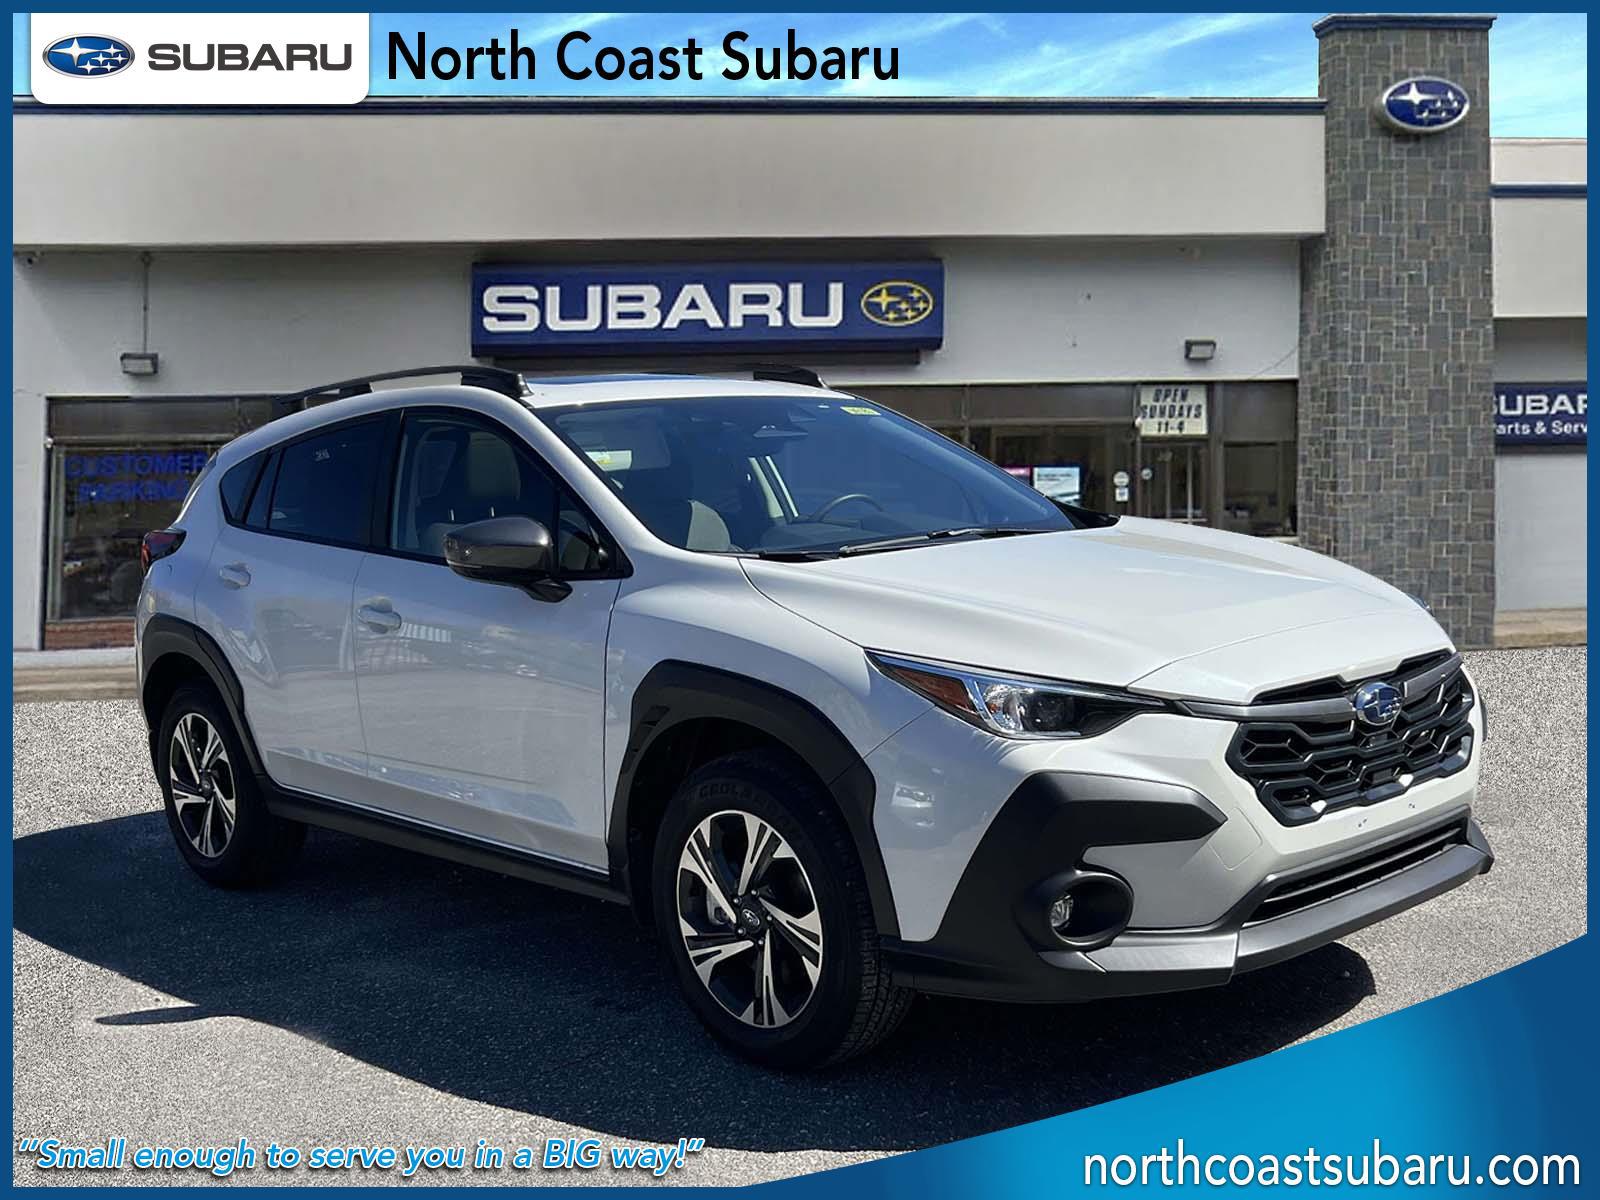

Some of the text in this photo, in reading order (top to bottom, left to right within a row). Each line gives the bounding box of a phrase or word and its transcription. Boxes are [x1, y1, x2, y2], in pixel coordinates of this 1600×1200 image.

[482, 282, 843, 332] SUBARU
[1153, 388, 1189, 403] OPEN
[1139, 404, 1203, 419] SUNDAYS
[1157, 420, 1185, 433] 11-4
[1534, 420, 1546, 435] &
[65, 452, 208, 477] CUSTOMER
